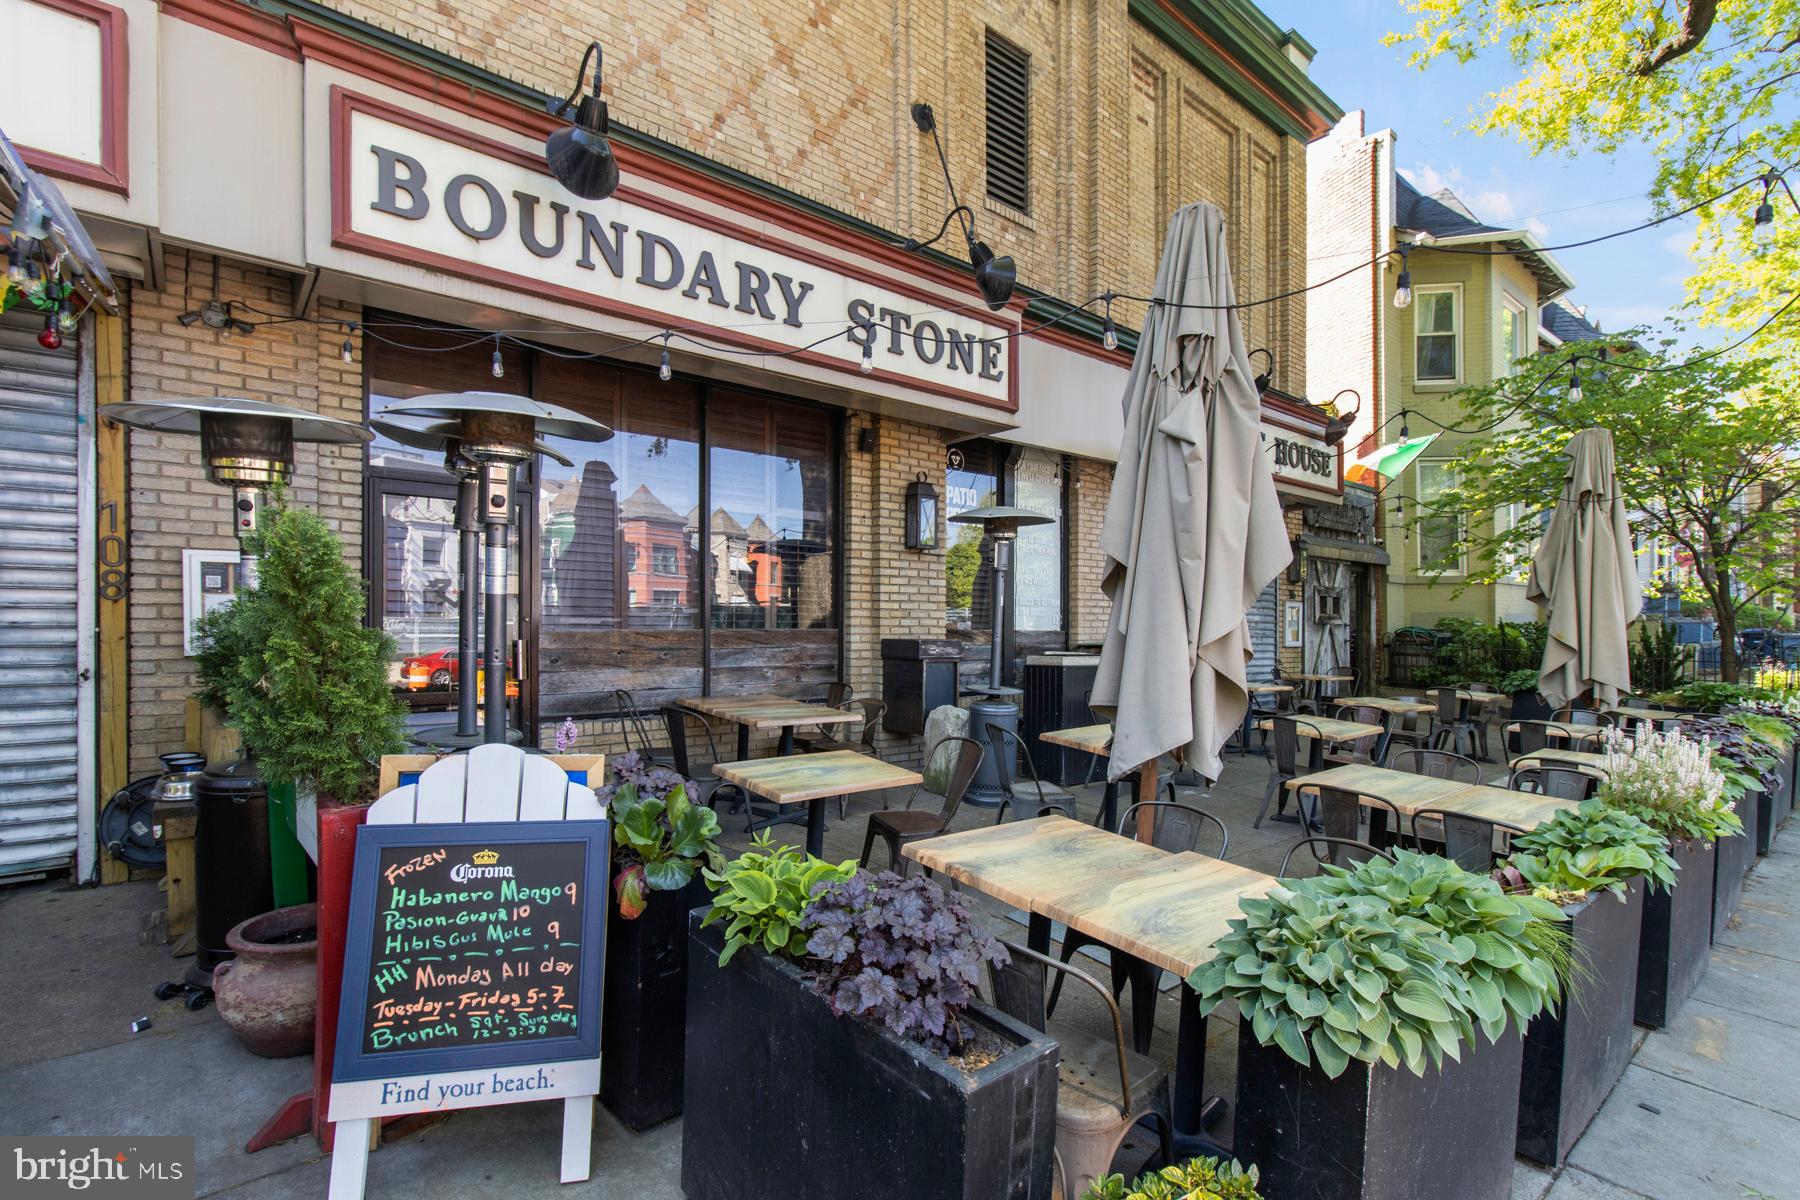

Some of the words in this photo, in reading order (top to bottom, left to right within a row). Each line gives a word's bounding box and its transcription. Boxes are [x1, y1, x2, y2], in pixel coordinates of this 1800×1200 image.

[370, 144, 815, 328] BOUNDARY
[847, 298, 1004, 383] STONE
[1273, 437, 1332, 478] HOUSE
[450, 863, 515, 884] Corona
[390, 886, 495, 909] Habanero
[501, 879, 561, 905] Mango
[564, 881, 577, 905] 9
[513, 904, 531, 922] 10
[547, 921, 560, 940] 9
[415, 964, 491, 991] Monday
[502, 961, 529, 982] All
[540, 956, 574, 976] day
[370, 1022, 458, 1050] Brunch
[381, 1079, 431, 1106] Find
[437, 1080, 485, 1107] your
[492, 1068, 555, 1095] beach.
